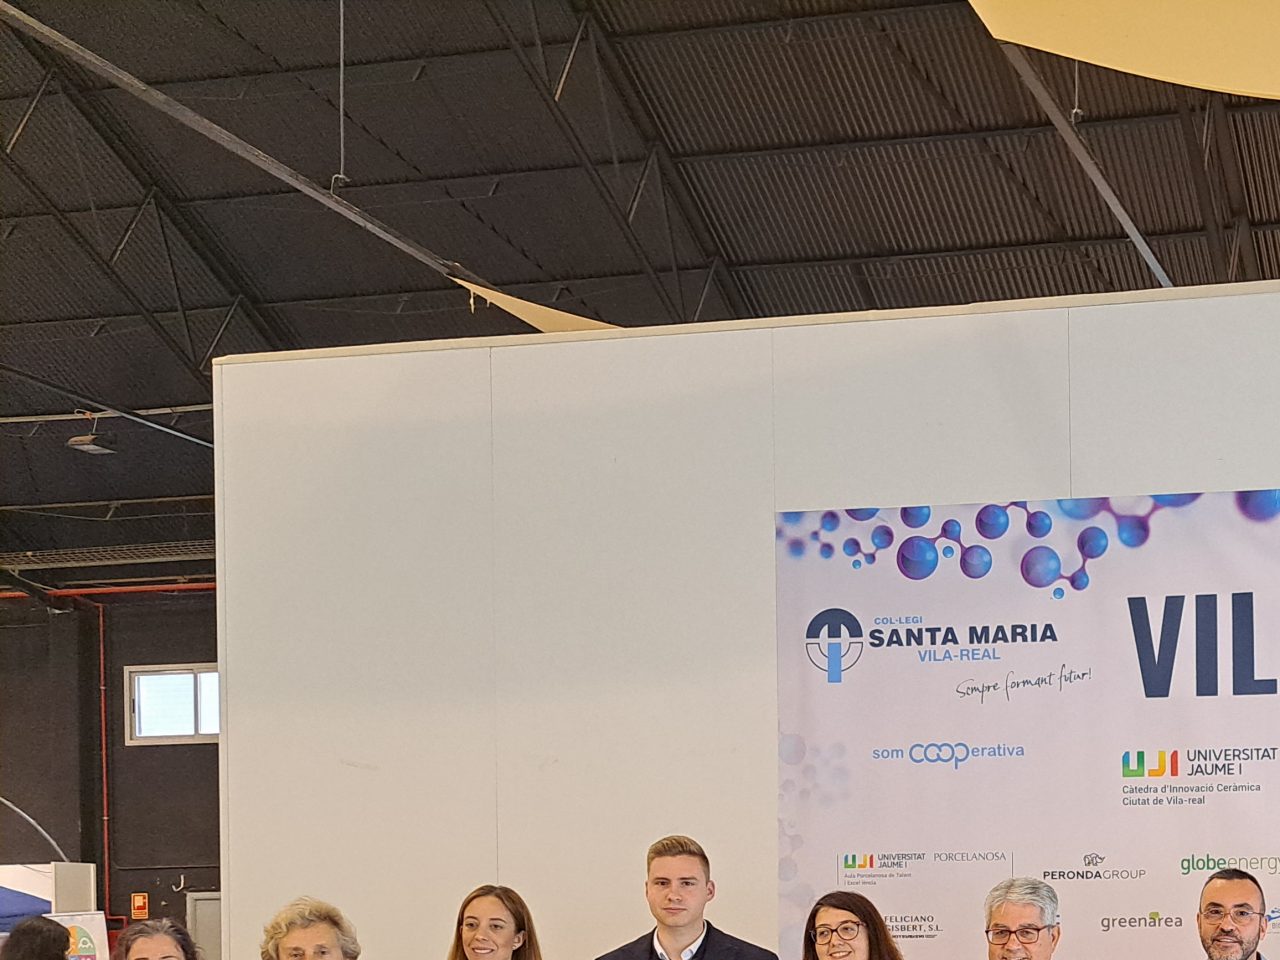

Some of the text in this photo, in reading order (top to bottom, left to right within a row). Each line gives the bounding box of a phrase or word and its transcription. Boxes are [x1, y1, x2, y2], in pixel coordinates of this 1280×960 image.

[869, 623, 1058, 648] SANTA MARIA
[918, 647, 1001, 662] VILA-REAL
[956, 663, 1092, 704] Sempre formant futur!
[872, 748, 904, 760] som
[1186, 747, 1279, 762] UNIVERSITAT
[1187, 762, 1242, 777] JAUME I
[1122, 782, 1261, 795] Càtedra d'Innovació Ceràmica
[1122, 795, 1206, 806] Ciutat de Vila-real
[877, 852, 926, 861] UNIVERSITAT
[934, 851, 1007, 862] PORCELANOSA
[878, 861, 903, 869] JAUME
[884, 915, 935, 923] FELICIANO
[1101, 915, 1183, 931] greenarea
